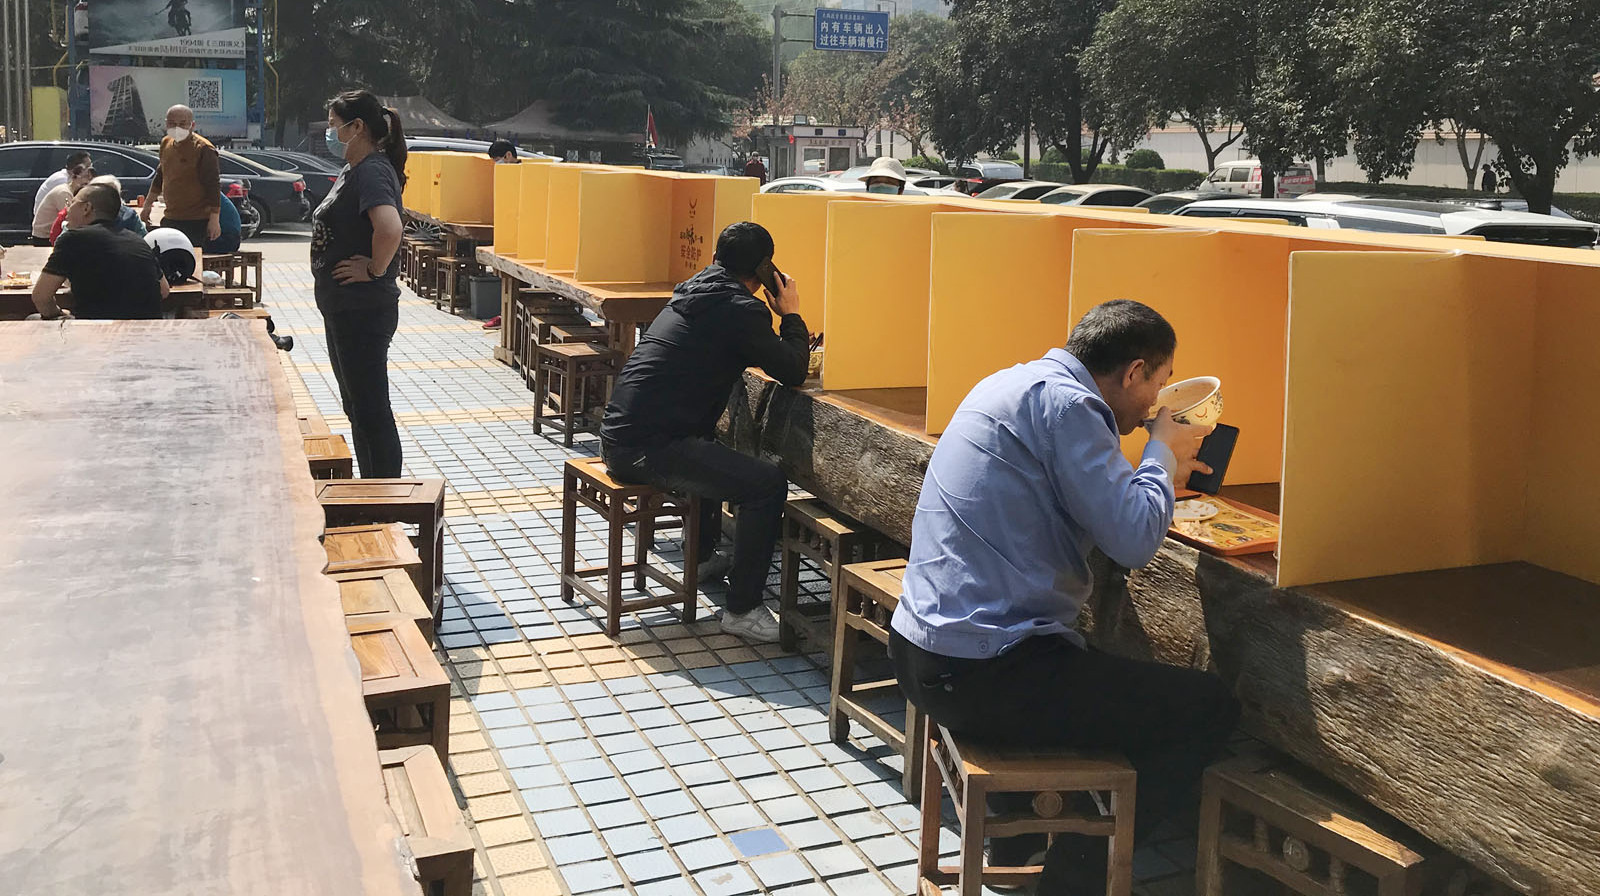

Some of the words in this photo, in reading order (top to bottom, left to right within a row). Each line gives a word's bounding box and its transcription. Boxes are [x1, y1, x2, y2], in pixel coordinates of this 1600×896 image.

[820, 21, 884, 35] 内有车辆出入
[820, 34, 884, 48] 过往车辆请慢行
